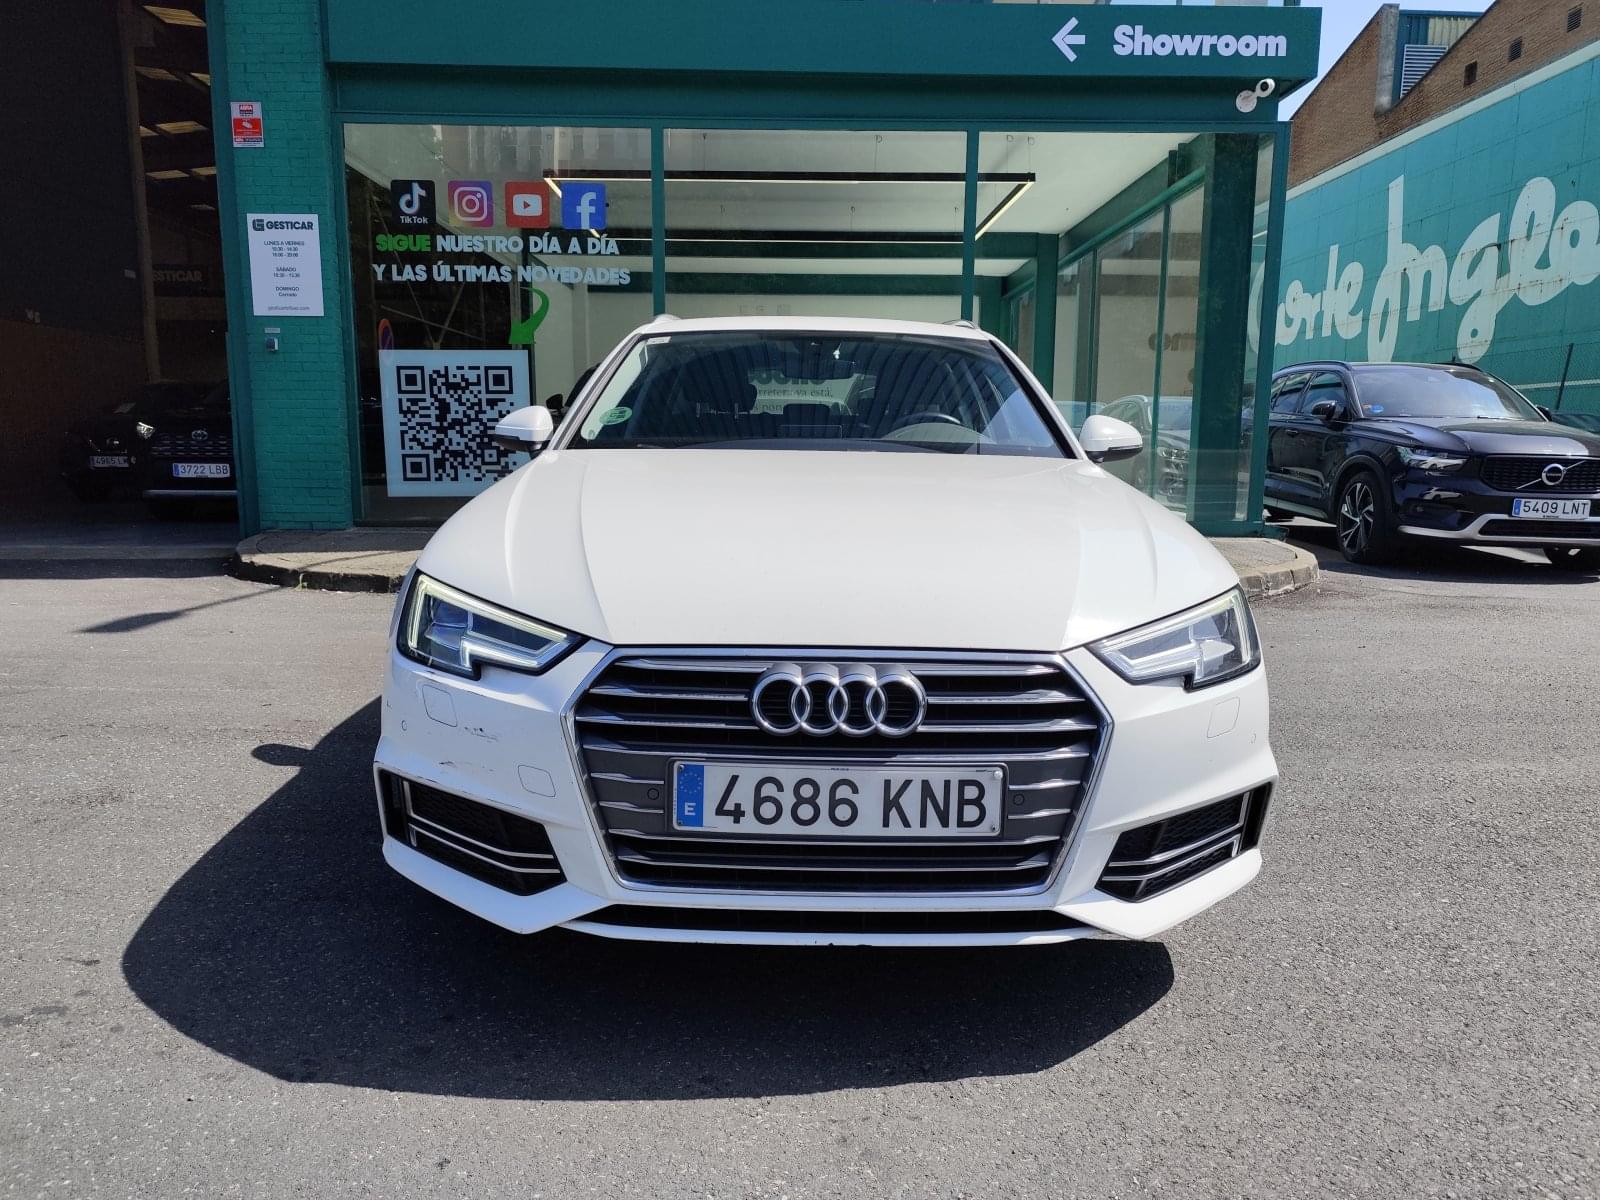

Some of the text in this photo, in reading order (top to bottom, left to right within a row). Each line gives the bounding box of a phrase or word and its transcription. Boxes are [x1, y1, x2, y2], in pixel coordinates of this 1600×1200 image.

[1113, 24, 1287, 57] Showroom
[265, 220, 314, 231] GESTICAR
[400, 215, 429, 224] TikTok
[375, 231, 620, 255] SIGUE NUESTRO DÍA A DÍA
[372, 260, 631, 285] Y LAS ÚLTIMAS NOVEDADES
[180, 464, 229, 475] 3722 LBB
[1523, 500, 1589, 515] 5409 LNT
[684, 802, 696, 816] E
[714, 774, 859, 828] 4686
[882, 778, 987, 829] KNB
